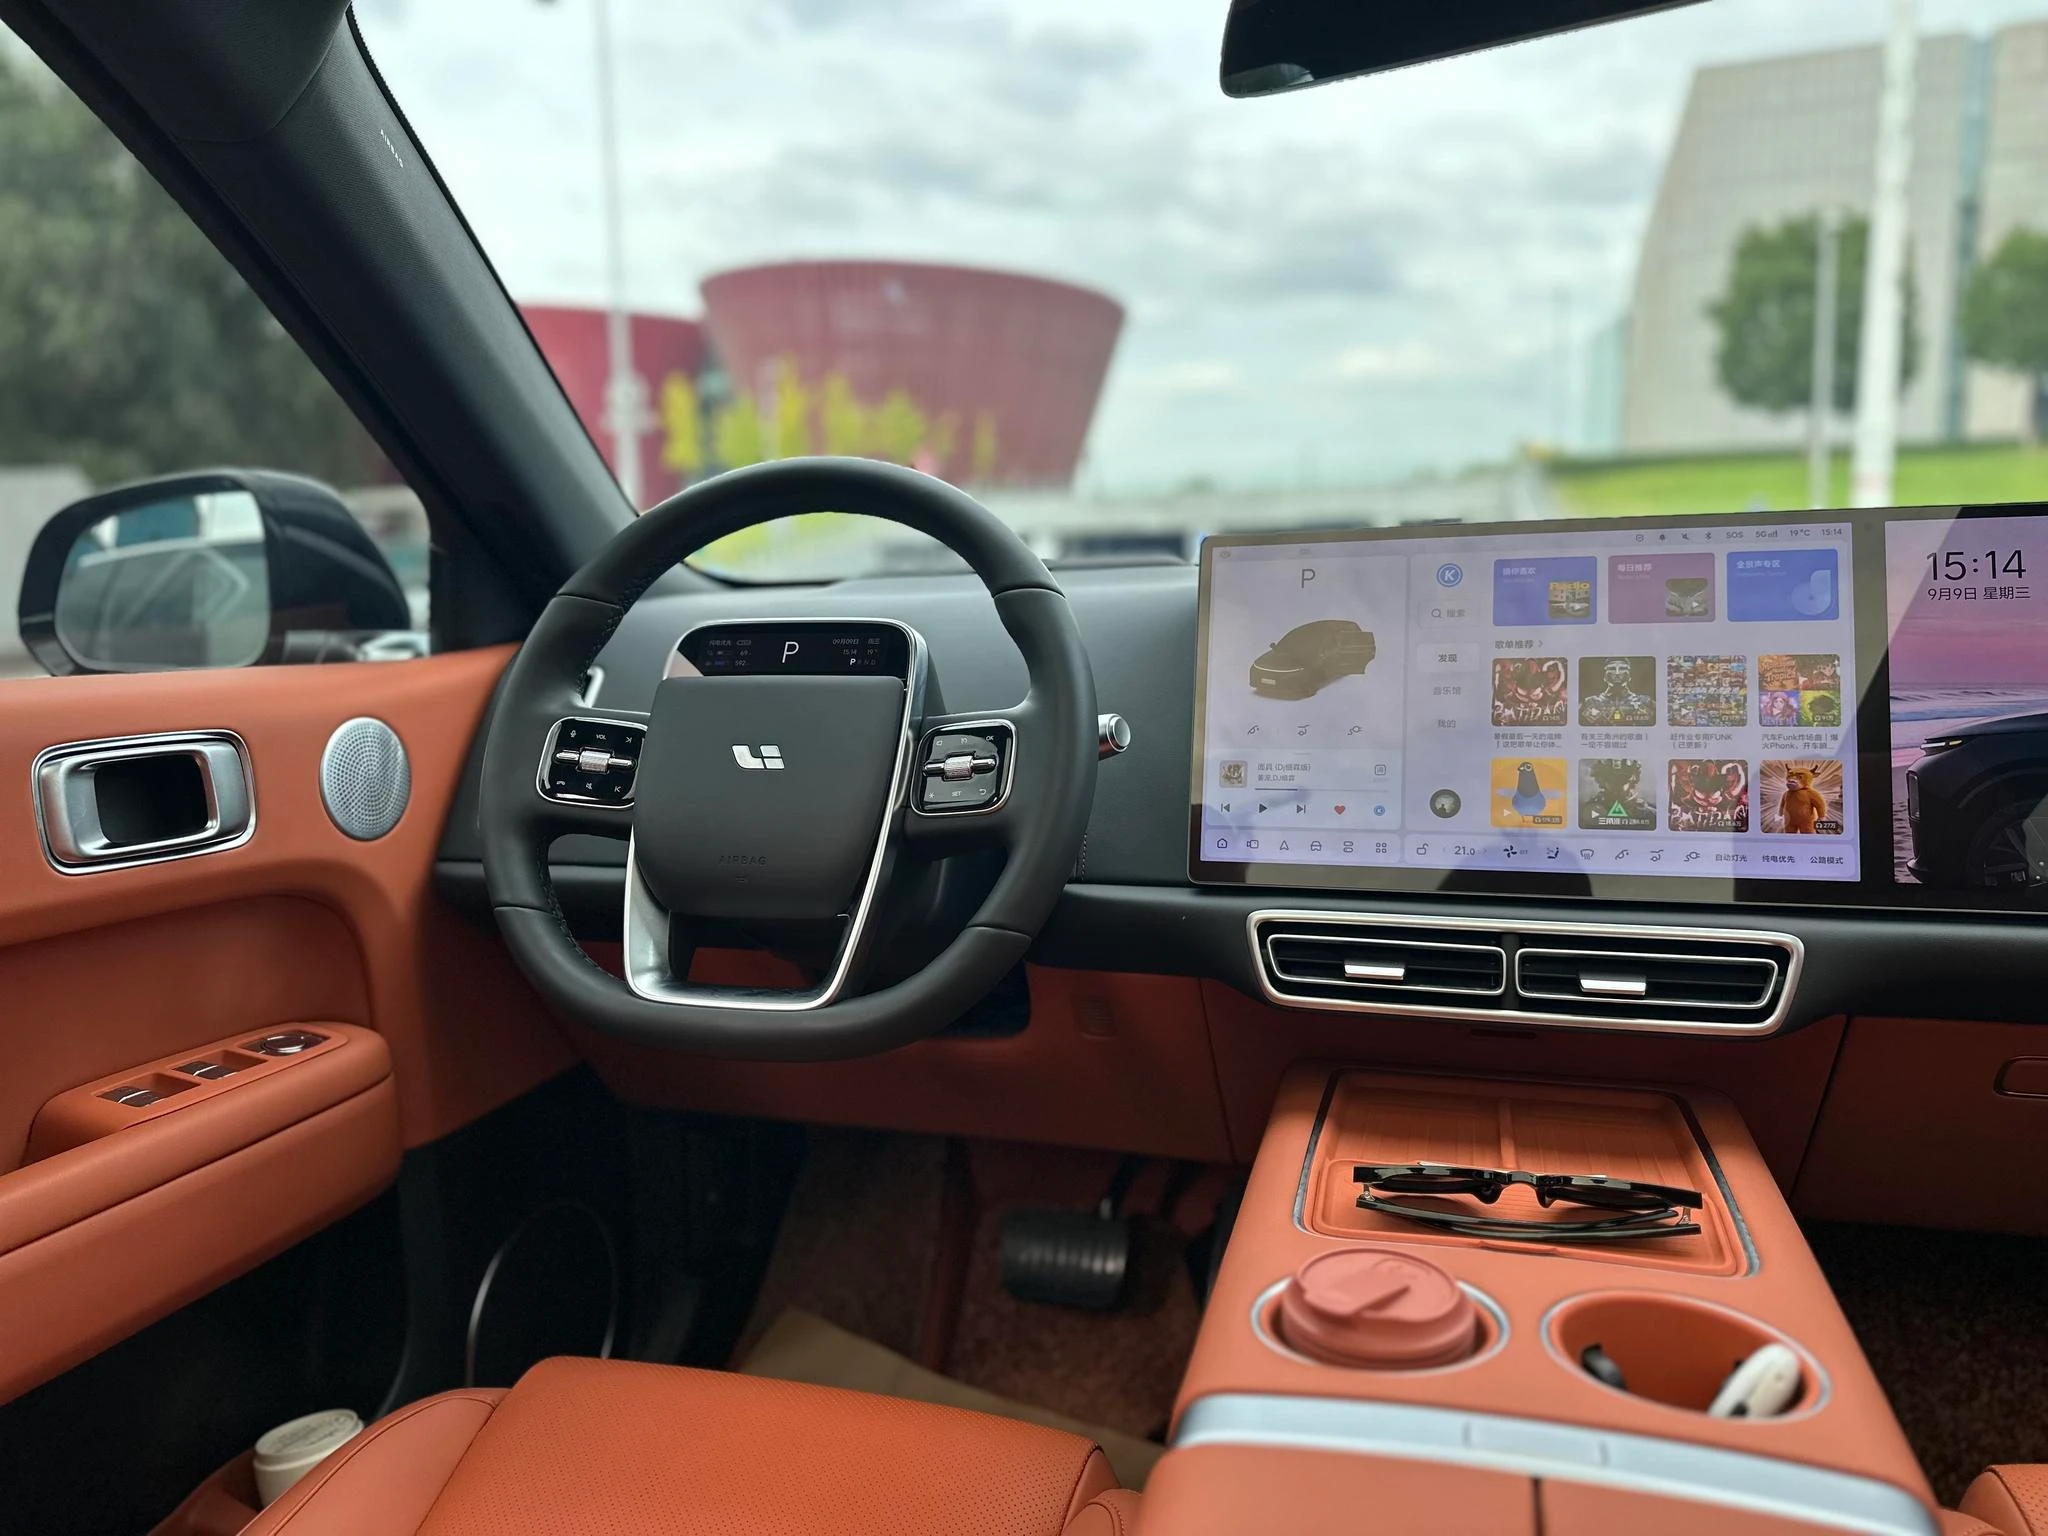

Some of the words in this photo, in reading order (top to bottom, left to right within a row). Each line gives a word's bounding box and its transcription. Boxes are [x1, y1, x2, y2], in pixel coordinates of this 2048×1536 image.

[1726, 531, 1744, 539] SOS
[1822, 528, 1842, 536] 15:14
[1926, 550, 2027, 581] 15:14
[1301, 568, 1316, 589] P
[1928, 587, 1978, 601] 9月9日
[1983, 586, 2031, 600] 星期三
[1494, 639, 1534, 649] 歌单推荐
[782, 641, 799, 663] P
[850, 658, 856, 666] P
[1438, 653, 1458, 664] 发现
[1433, 686, 1462, 696] 音乐馆
[1437, 719, 1457, 729] 我的
[1454, 845, 1476, 856] 21.0
[718, 855, 768, 866] AIRBAG
[1715, 854, 1748, 862] 自动灯光
[1762, 855, 1796, 863] 纯电优先
[1810, 856, 1844, 865] 公路模式
